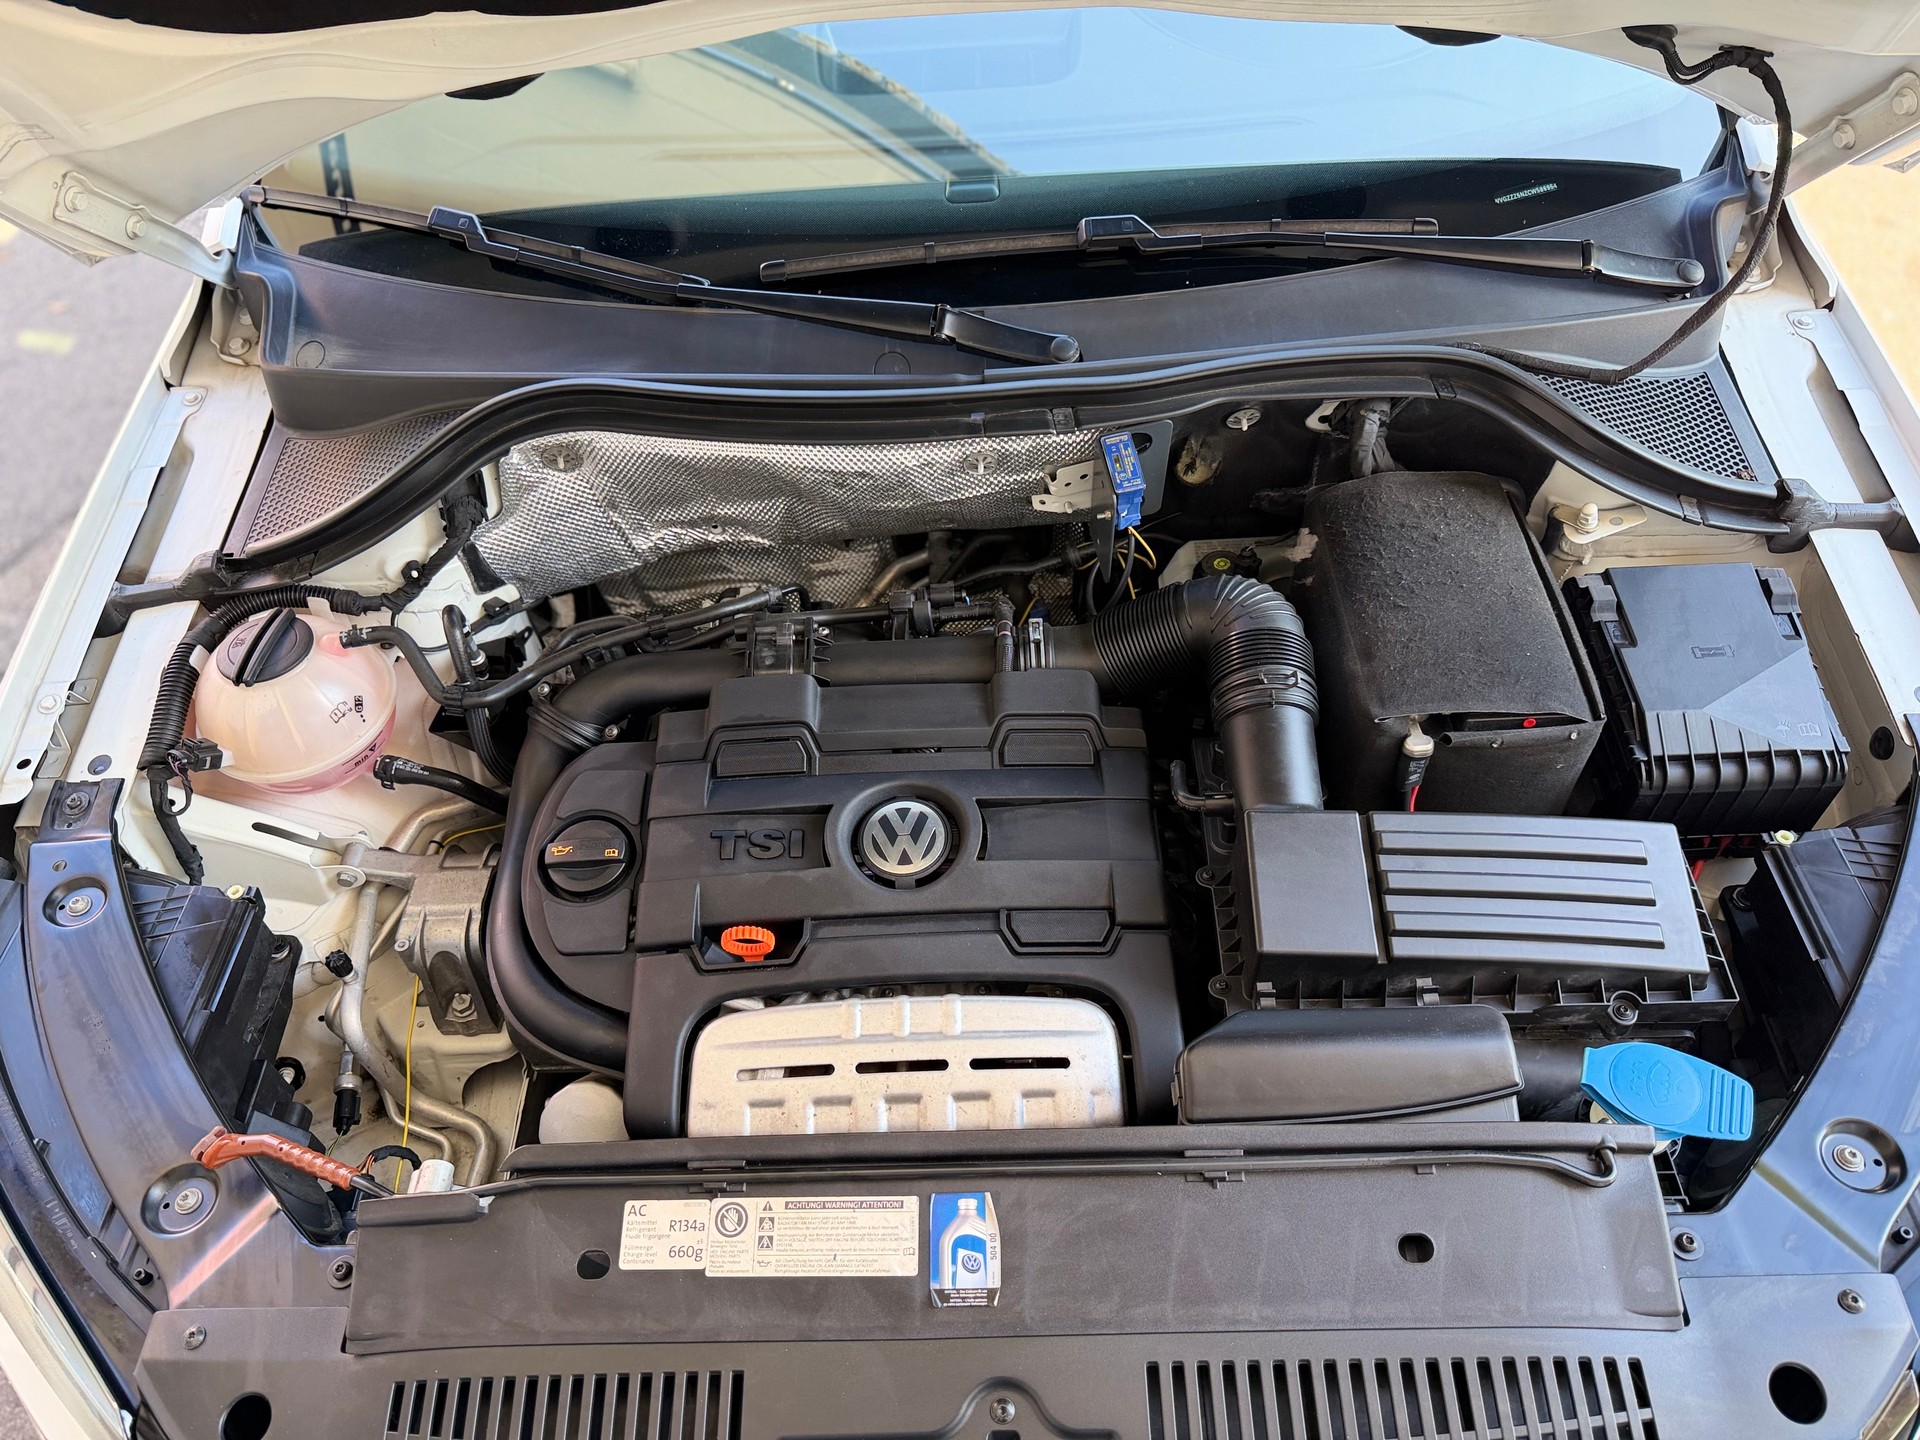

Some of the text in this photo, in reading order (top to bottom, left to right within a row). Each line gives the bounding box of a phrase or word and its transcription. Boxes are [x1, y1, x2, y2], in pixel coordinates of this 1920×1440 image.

[354, 754, 369, 767] min
[710, 829, 805, 860] TSI
[627, 1204, 648, 1217] AC
[824, 1201, 860, 1209] WARNING!
[669, 1219, 706, 1232] R134a
[623, 1251, 642, 1259] Charge
[668, 1245, 704, 1262] 660g
[990, 1246, 998, 1261] 504
